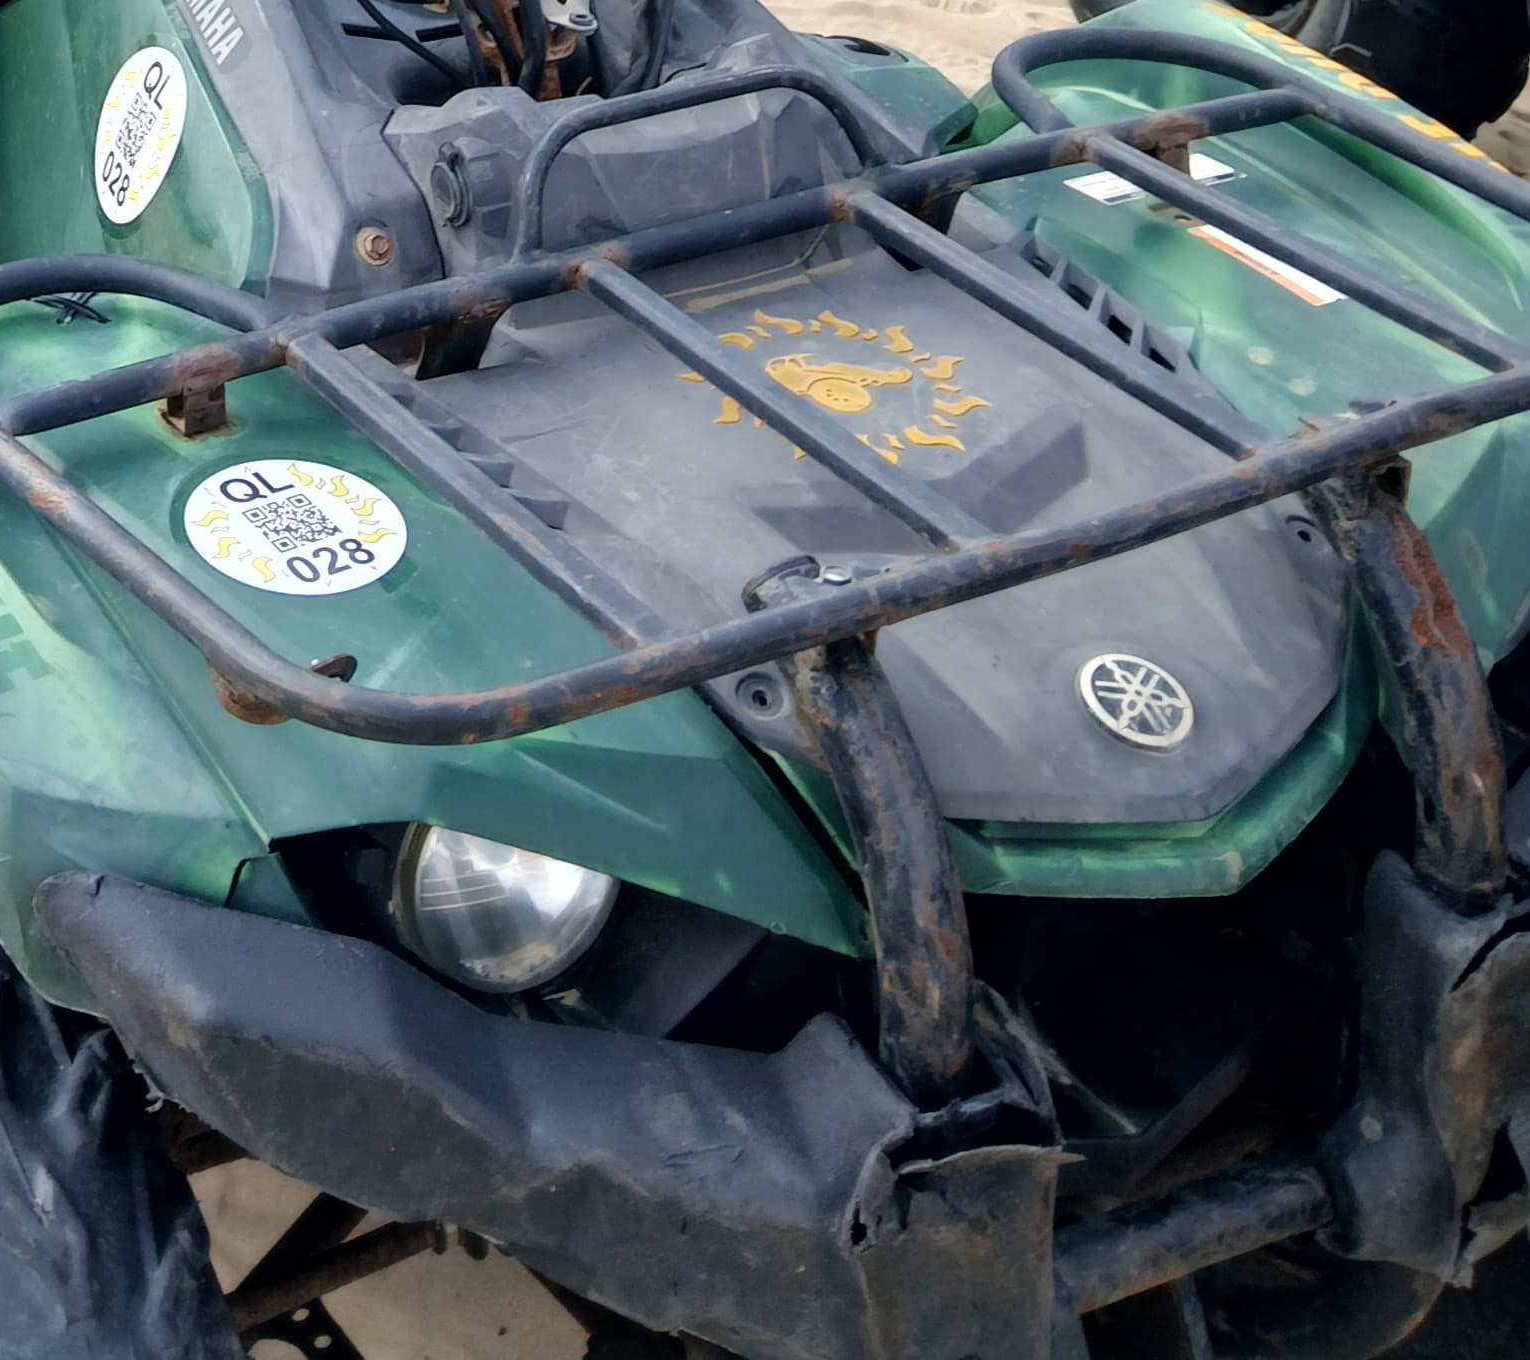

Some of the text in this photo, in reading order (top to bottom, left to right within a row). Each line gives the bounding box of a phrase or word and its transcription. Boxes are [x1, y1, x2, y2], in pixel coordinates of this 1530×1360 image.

[144, 61, 170, 110] QL
[102, 150, 130, 207] 028
[220, 471, 295, 503] QL
[286, 538, 375, 583] 028
